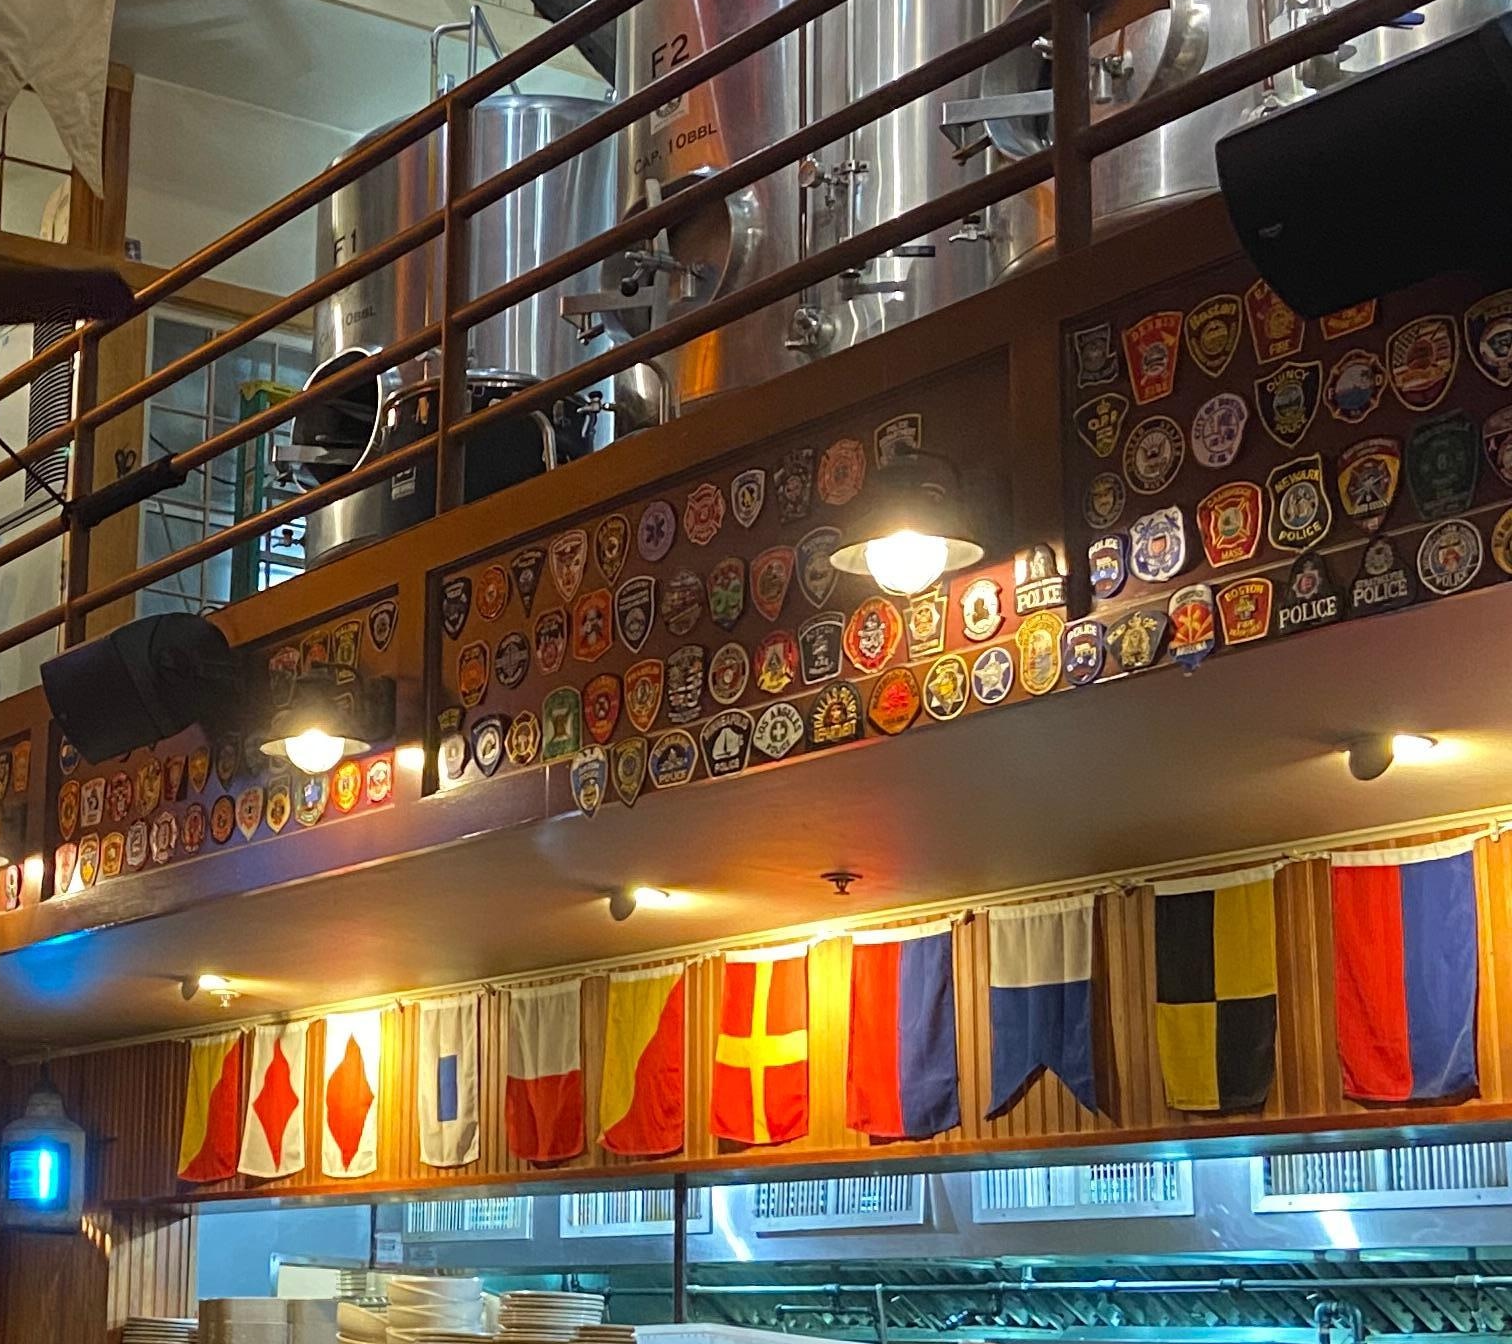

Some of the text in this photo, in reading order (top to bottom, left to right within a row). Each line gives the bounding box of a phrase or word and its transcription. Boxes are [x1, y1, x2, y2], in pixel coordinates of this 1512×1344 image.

[651, 34, 690, 78] F2
[633, 123, 718, 175] CAP. 10BBL
[334, 229, 357, 265] F1
[1278, 520, 1322, 541] POLICE
[1089, 536, 1118, 553] POLICE
[1435, 570, 1468, 587] POLICE
[1016, 584, 1065, 614] POLICE
[1223, 583, 1263, 601] BOSTON
[1353, 578, 1409, 607] POLICE
[1278, 596, 1337, 629] POLICE
[1066, 624, 1097, 644] POLICE
[713, 759, 740, 774] POLICE
